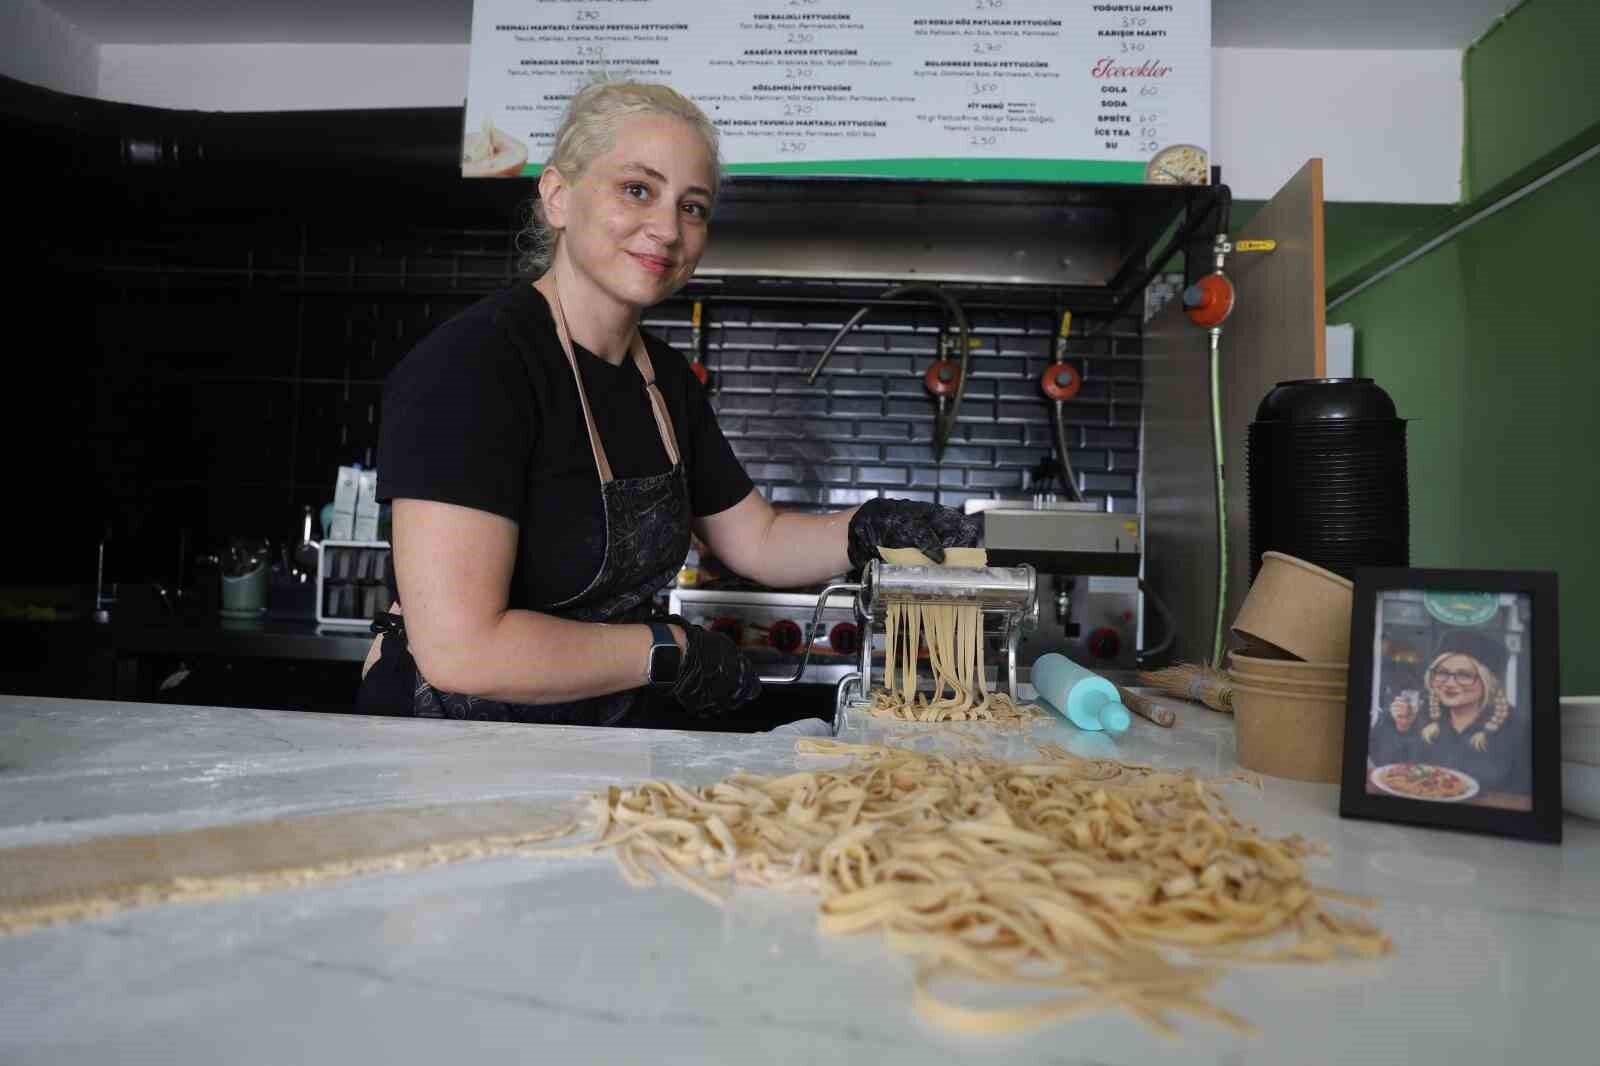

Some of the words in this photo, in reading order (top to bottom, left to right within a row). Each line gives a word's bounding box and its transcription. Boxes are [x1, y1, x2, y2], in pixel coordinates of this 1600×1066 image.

[1093, 4, 1141, 13] YOĞURTLU
[1142, 4, 1173, 12] MANTI
[1097, 29, 1135, 38] KARIŞIK
[1136, 29, 1167, 37] MANTI
[1101, 85, 1127, 94] COLA
[1101, 100, 1127, 108] SODA
[1098, 114, 1131, 123] SPRİTE
[1094, 127, 1110, 137] İCE
[1112, 127, 1130, 137] TEA
